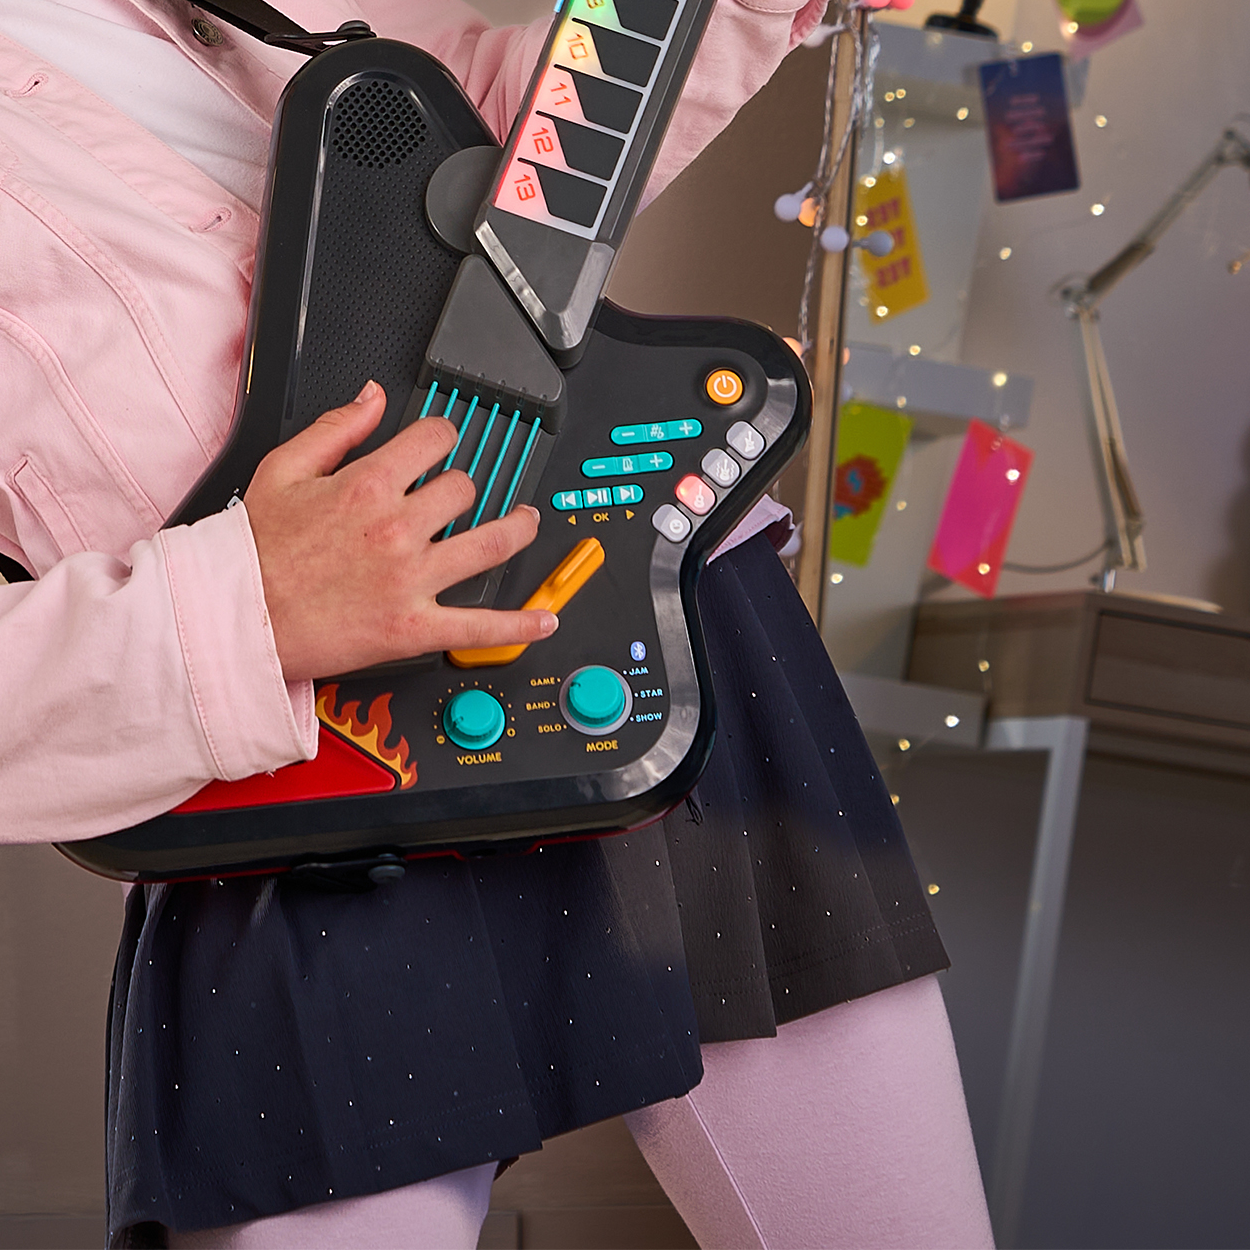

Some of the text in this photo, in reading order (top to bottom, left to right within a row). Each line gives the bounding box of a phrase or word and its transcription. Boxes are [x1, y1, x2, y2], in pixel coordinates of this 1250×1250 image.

[565, 33, 589, 60] 10
[550, 82, 572, 106] 11
[531, 126, 554, 155] 12
[514, 174, 536, 201] 13
[593, 512, 609, 522] OK
[629, 667, 649, 676] JAM
[530, 677, 555, 687] GAME
[640, 689, 663, 698] STAR
[526, 701, 550, 711] BAND
[636, 713, 662, 722] SHOW
[538, 723, 562, 734] SOLO
[586, 740, 618, 752] MODE
[457, 752, 502, 765] VOLUME
